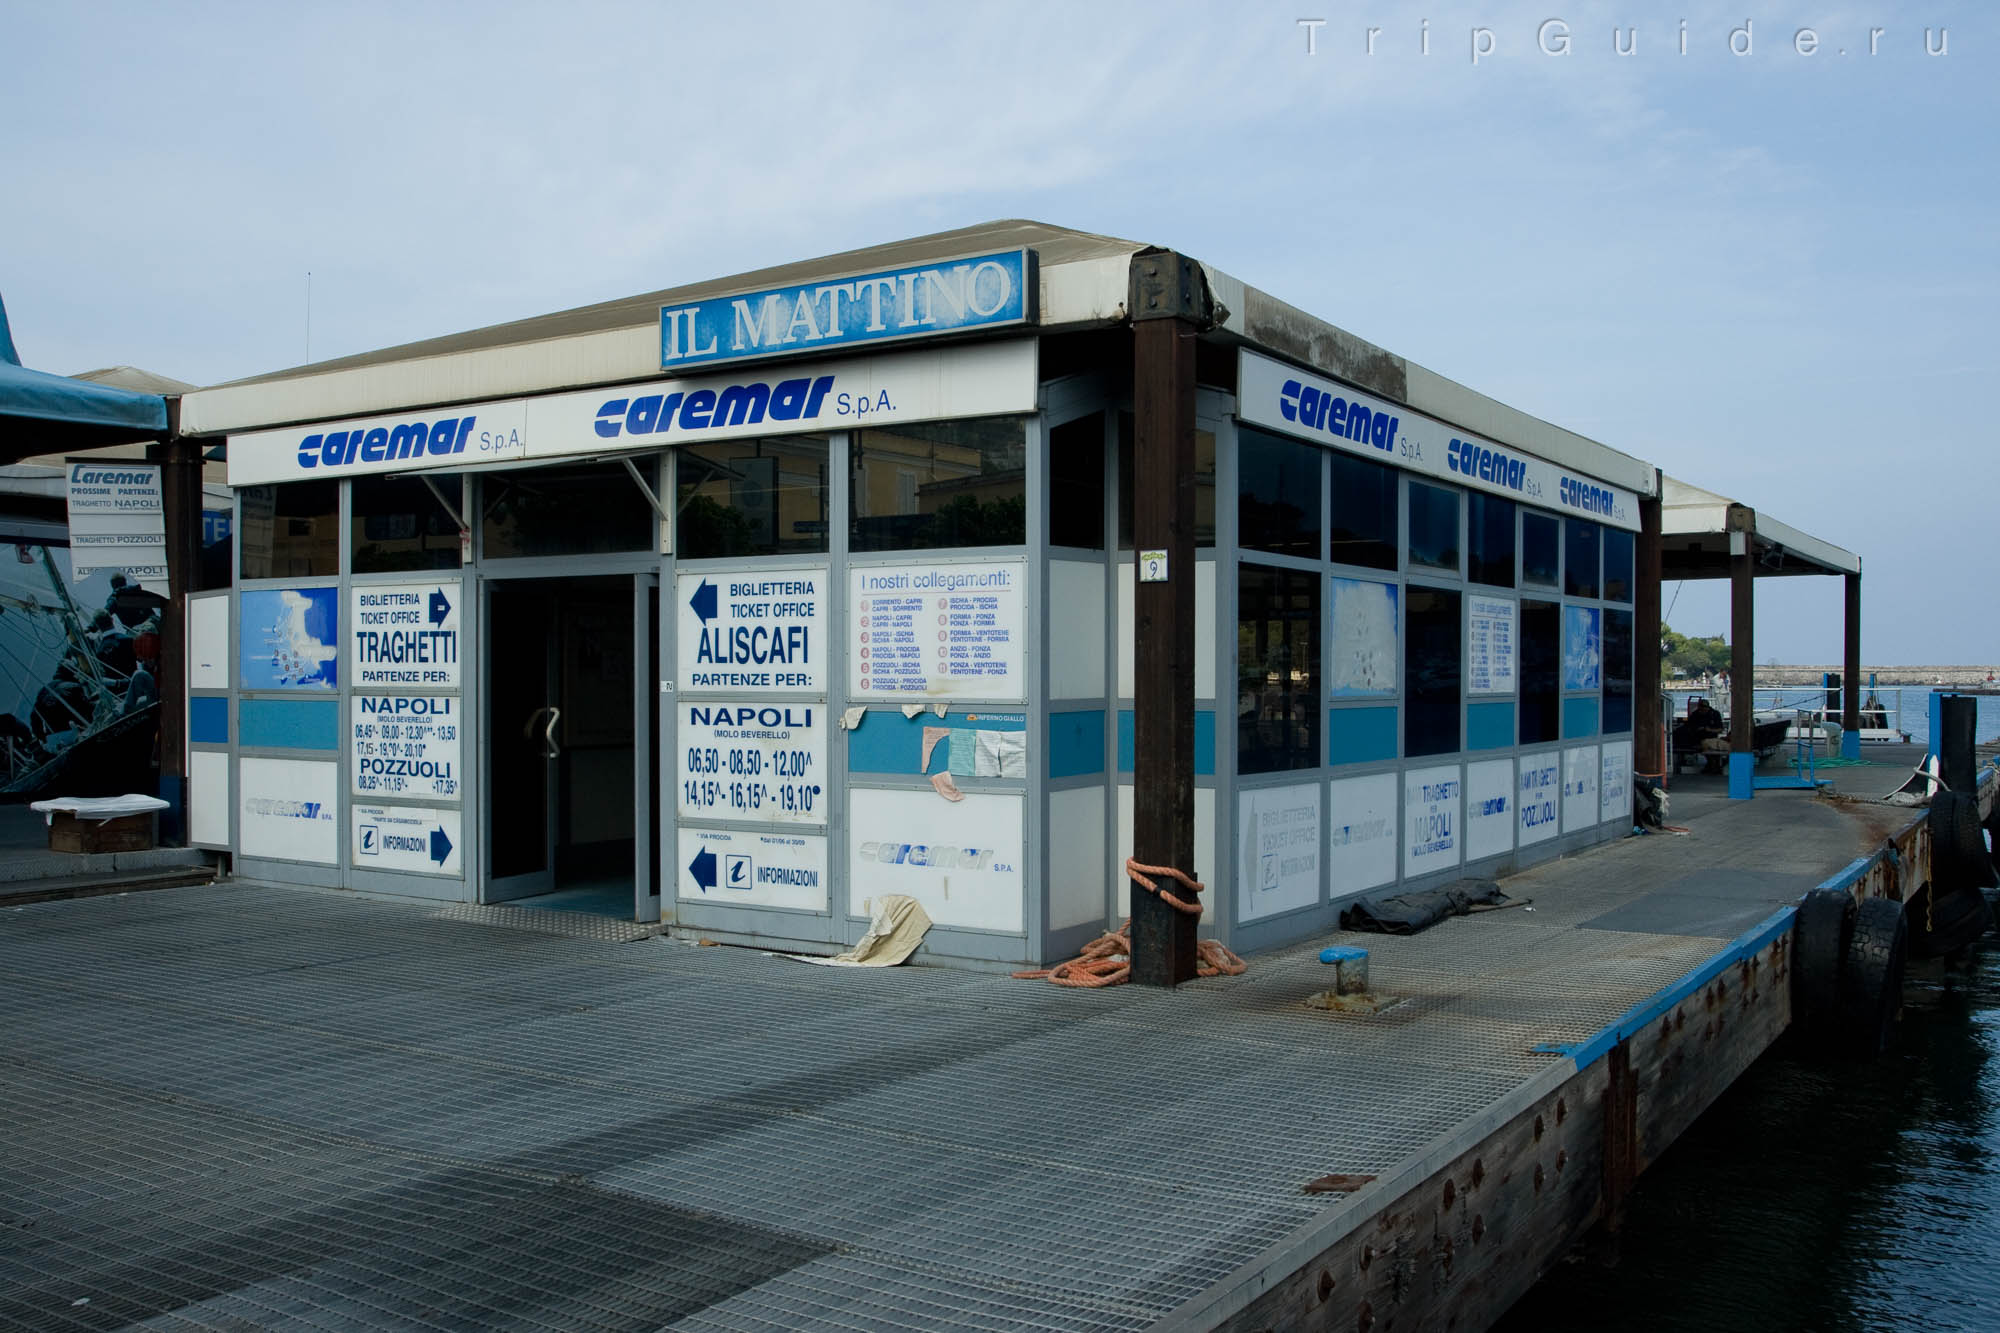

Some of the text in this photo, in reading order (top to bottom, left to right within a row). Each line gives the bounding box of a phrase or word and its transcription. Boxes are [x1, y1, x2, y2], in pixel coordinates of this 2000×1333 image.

[665, 262, 1011, 361] IL MATTINO
[594, 376, 896, 438] caremar S.p.A.
[1280, 379, 1424, 462] caremar S.p.A.
[297, 416, 524, 468] caremar S.p.A.
[1447, 438, 1526, 492] caremar
[1560, 476, 1614, 517] caremar
[117, 536, 161, 544] POZZUOLI
[730, 582, 815, 596] BIGLIETTERIA
[870, 573, 909, 589] nostri
[360, 594, 420, 606] BIGLIETTERIA
[360, 611, 420, 624] TICKET OFFICE
[730, 602, 815, 618] TICKET OFFICE
[357, 631, 456, 663] TRAGHETTI
[697, 626, 808, 664] ALISCAFI
[363, 671, 450, 682] PARTENZE PER:
[692, 673, 812, 686] PARTENZE PER:
[361, 698, 450, 714] NAPOLI
[691, 707, 811, 728] NAPOLI
[714, 730, 790, 740] (MOLO BEVERELLO)
[360, 759, 450, 778] POZZUOLI
[689, 748, 719, 777] 06,50
[729, 749, 761, 779] 08,50
[1423, 781, 1459, 803] TRAGHETTO
[383, 835, 426, 852] INFORMAZIONI
[757, 866, 818, 888] INFORMAZIONI
[994, 863, 1014, 873] S.P.A.
